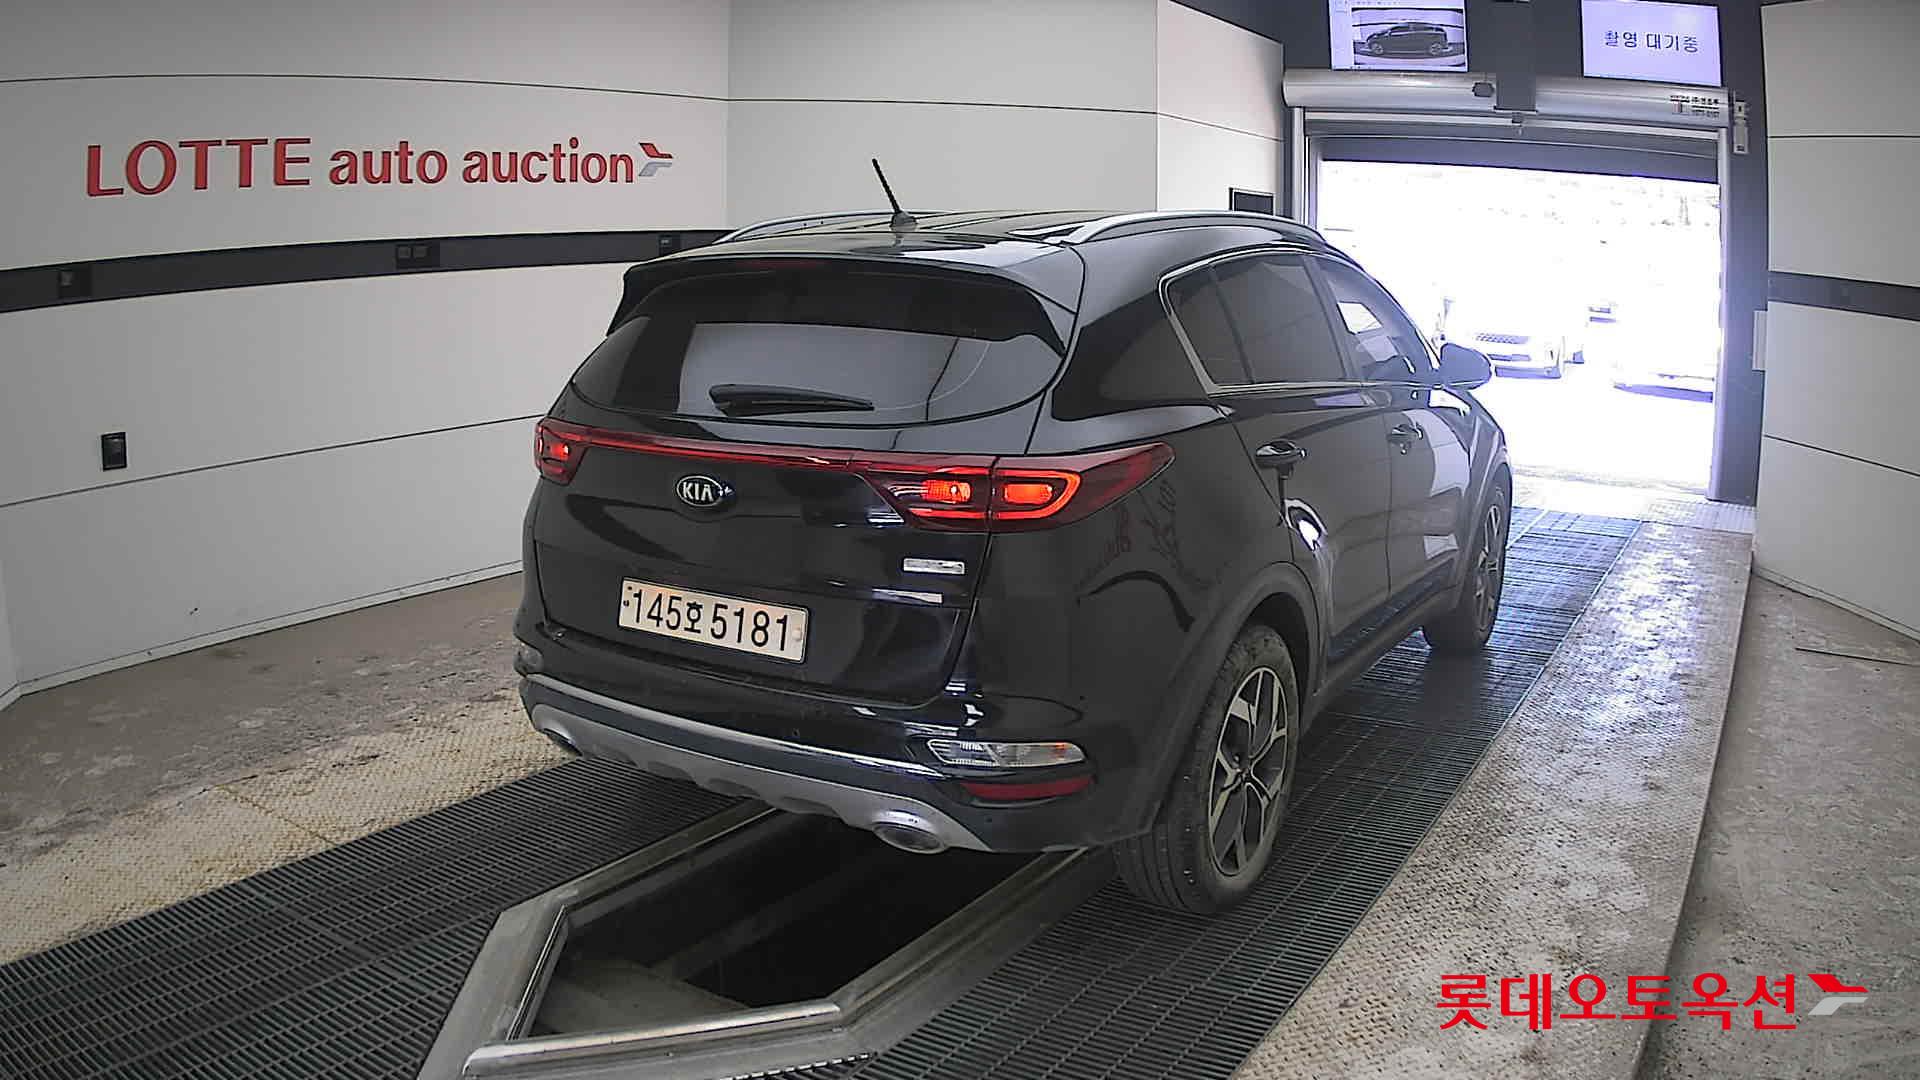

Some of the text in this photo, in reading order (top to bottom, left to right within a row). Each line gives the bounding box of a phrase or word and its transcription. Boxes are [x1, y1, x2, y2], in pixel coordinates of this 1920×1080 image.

[1646, 33, 1698, 53] 대기중
[86, 136, 634, 197] LOTTE auto auction
[683, 481, 714, 502] KIA
